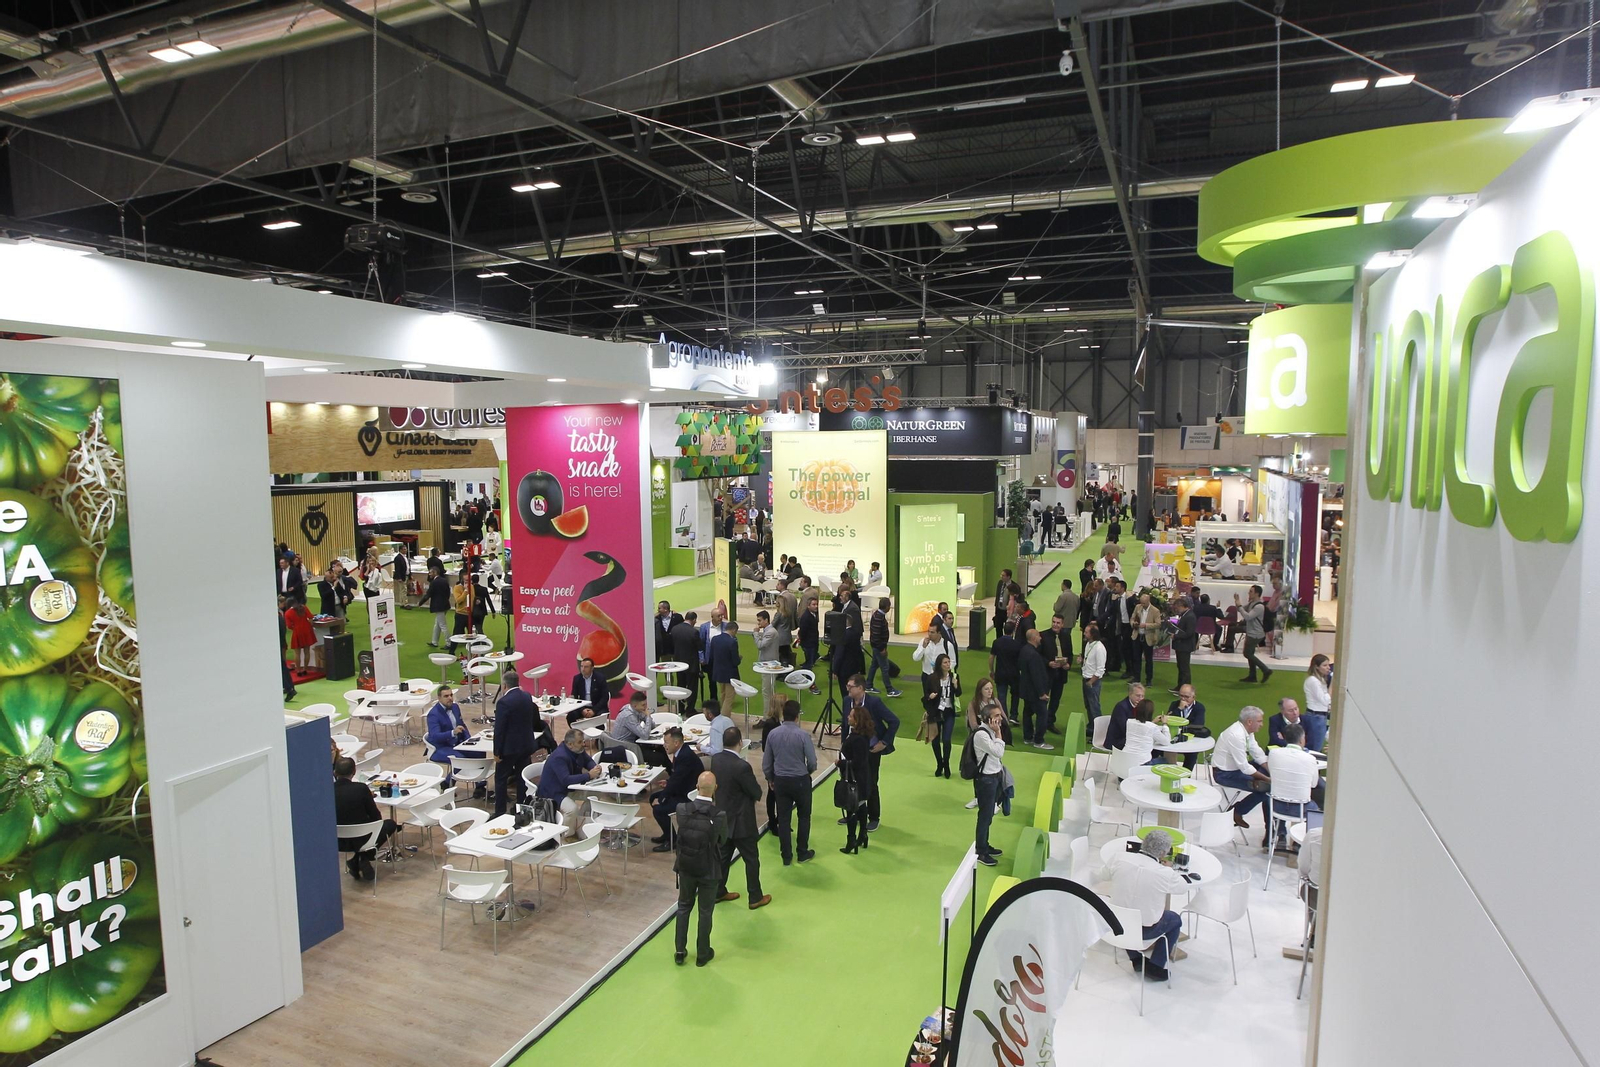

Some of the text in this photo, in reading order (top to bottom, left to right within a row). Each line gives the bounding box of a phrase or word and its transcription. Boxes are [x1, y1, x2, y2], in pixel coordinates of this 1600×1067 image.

[564, 415, 623, 427] Your new
[567, 428, 618, 461] tasty
[893, 435, 937, 443] IBERHANSE
[567, 454, 622, 478] snack
[788, 468, 871, 485] The power
[569, 482, 622, 498] is here!
[789, 486, 805, 500] of
[924, 541, 934, 552] In
[913, 575, 946, 586] nature
[519, 584, 575, 602] Easy to peel
[520, 603, 571, 616] Easy to eat
[521, 623, 581, 643] Easy to enjoy
[87, 727, 108, 742] Raf
